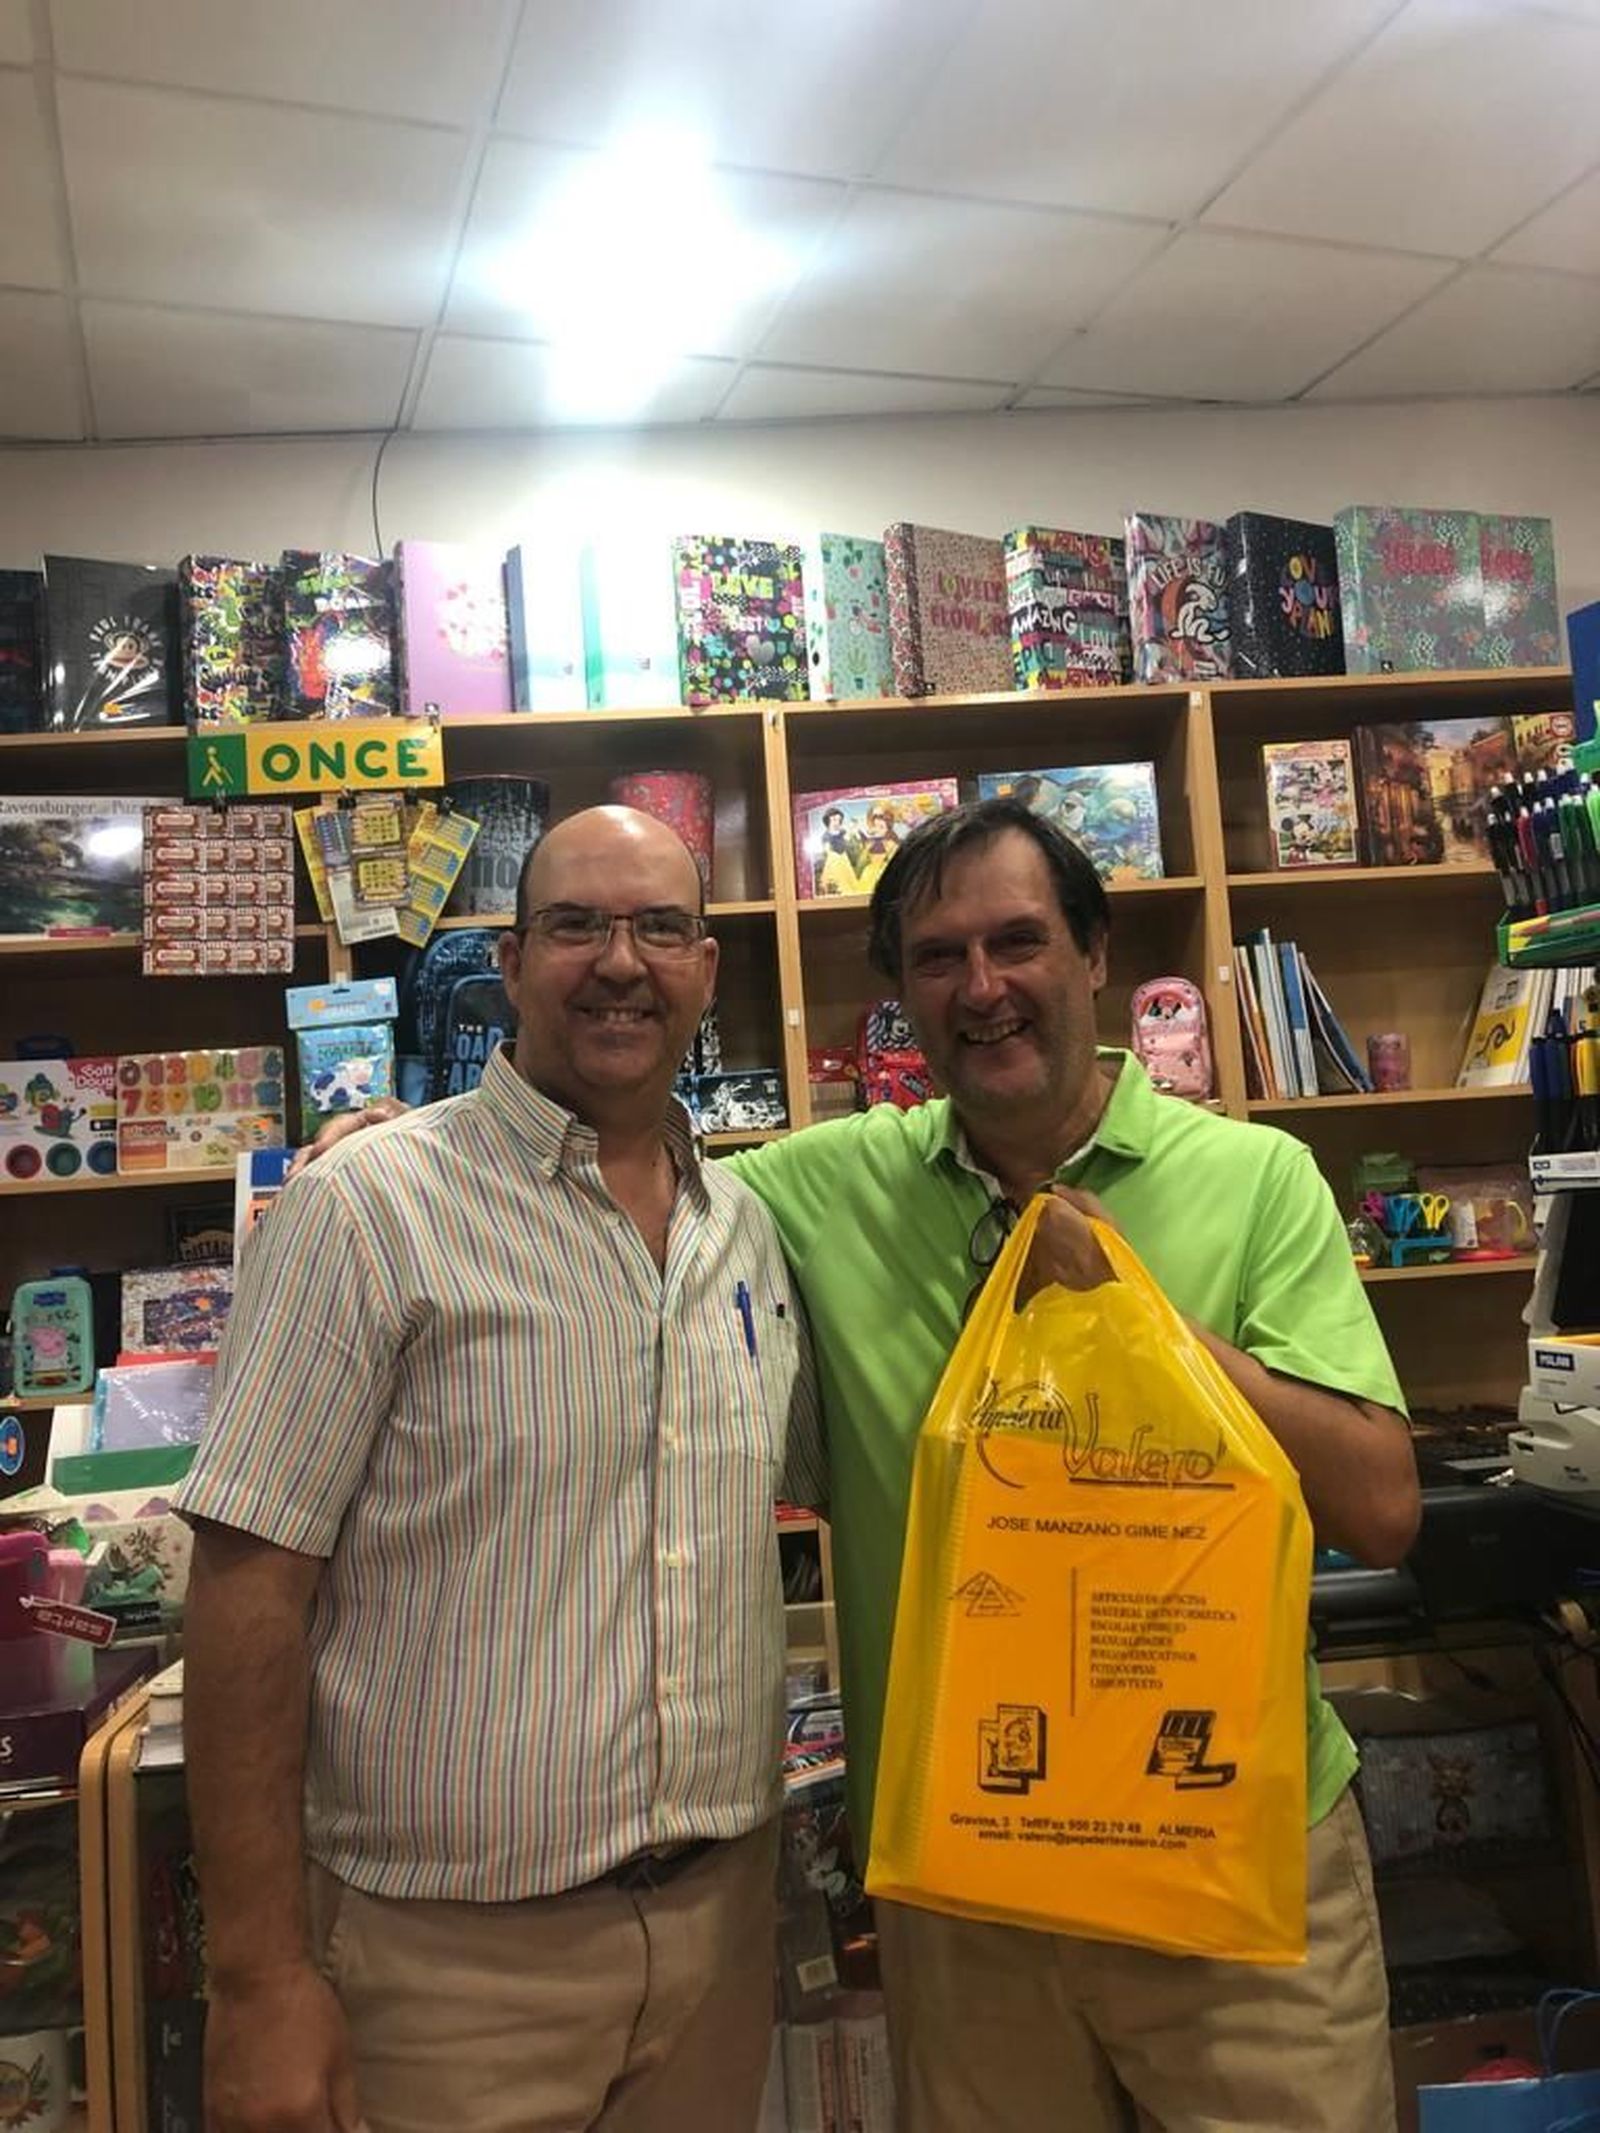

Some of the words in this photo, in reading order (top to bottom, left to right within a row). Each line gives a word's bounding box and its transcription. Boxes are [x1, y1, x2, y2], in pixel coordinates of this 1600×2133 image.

[1150, 560, 1182, 590] LIFE
[1185, 556, 1201, 577] IS
[261, 738, 429, 784] ONCE
[458, 1023, 484, 1034] THE
[81, 1063, 115, 1077] Soft
[121, 1089, 142, 1117] 7
[987, 1516, 1030, 1531] JOSE
[1034, 1518, 1121, 1537] MANZANO
[1124, 1522, 1168, 1539] GIME
[1172, 1525, 1207, 1541] NEZ
[1158, 1823, 1217, 1839] ALMERIA
